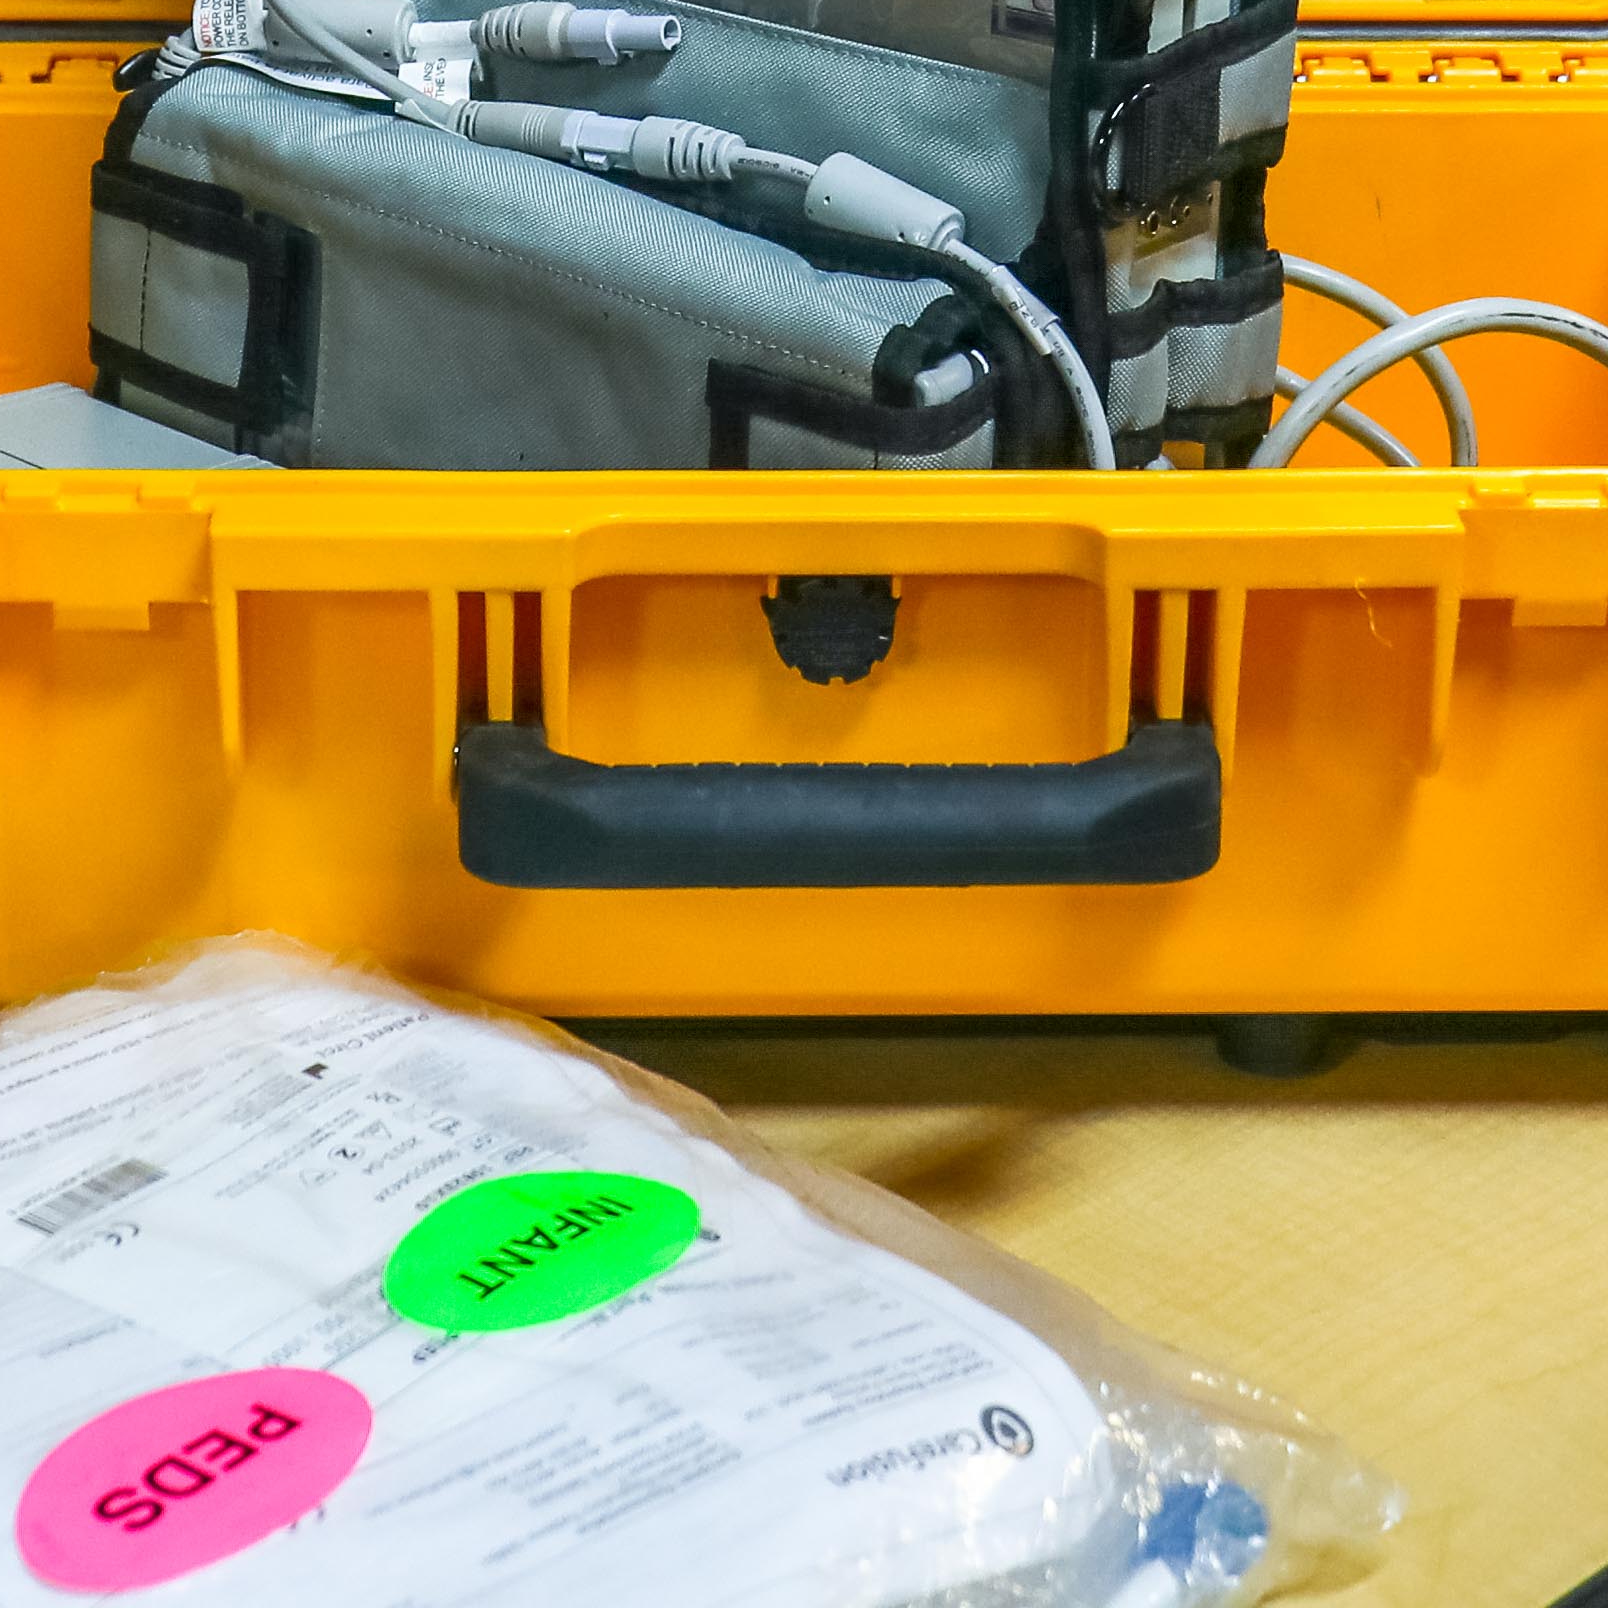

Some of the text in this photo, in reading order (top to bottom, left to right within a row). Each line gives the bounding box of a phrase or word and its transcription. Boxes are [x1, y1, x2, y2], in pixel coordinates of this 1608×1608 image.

[211, 11, 225, 48] POWER
[224, 27, 237, 47] THE
[237, 31, 249, 47] ON
[455, 1192, 636, 1302] INFANT
[92, 1401, 304, 1534] PEDS
